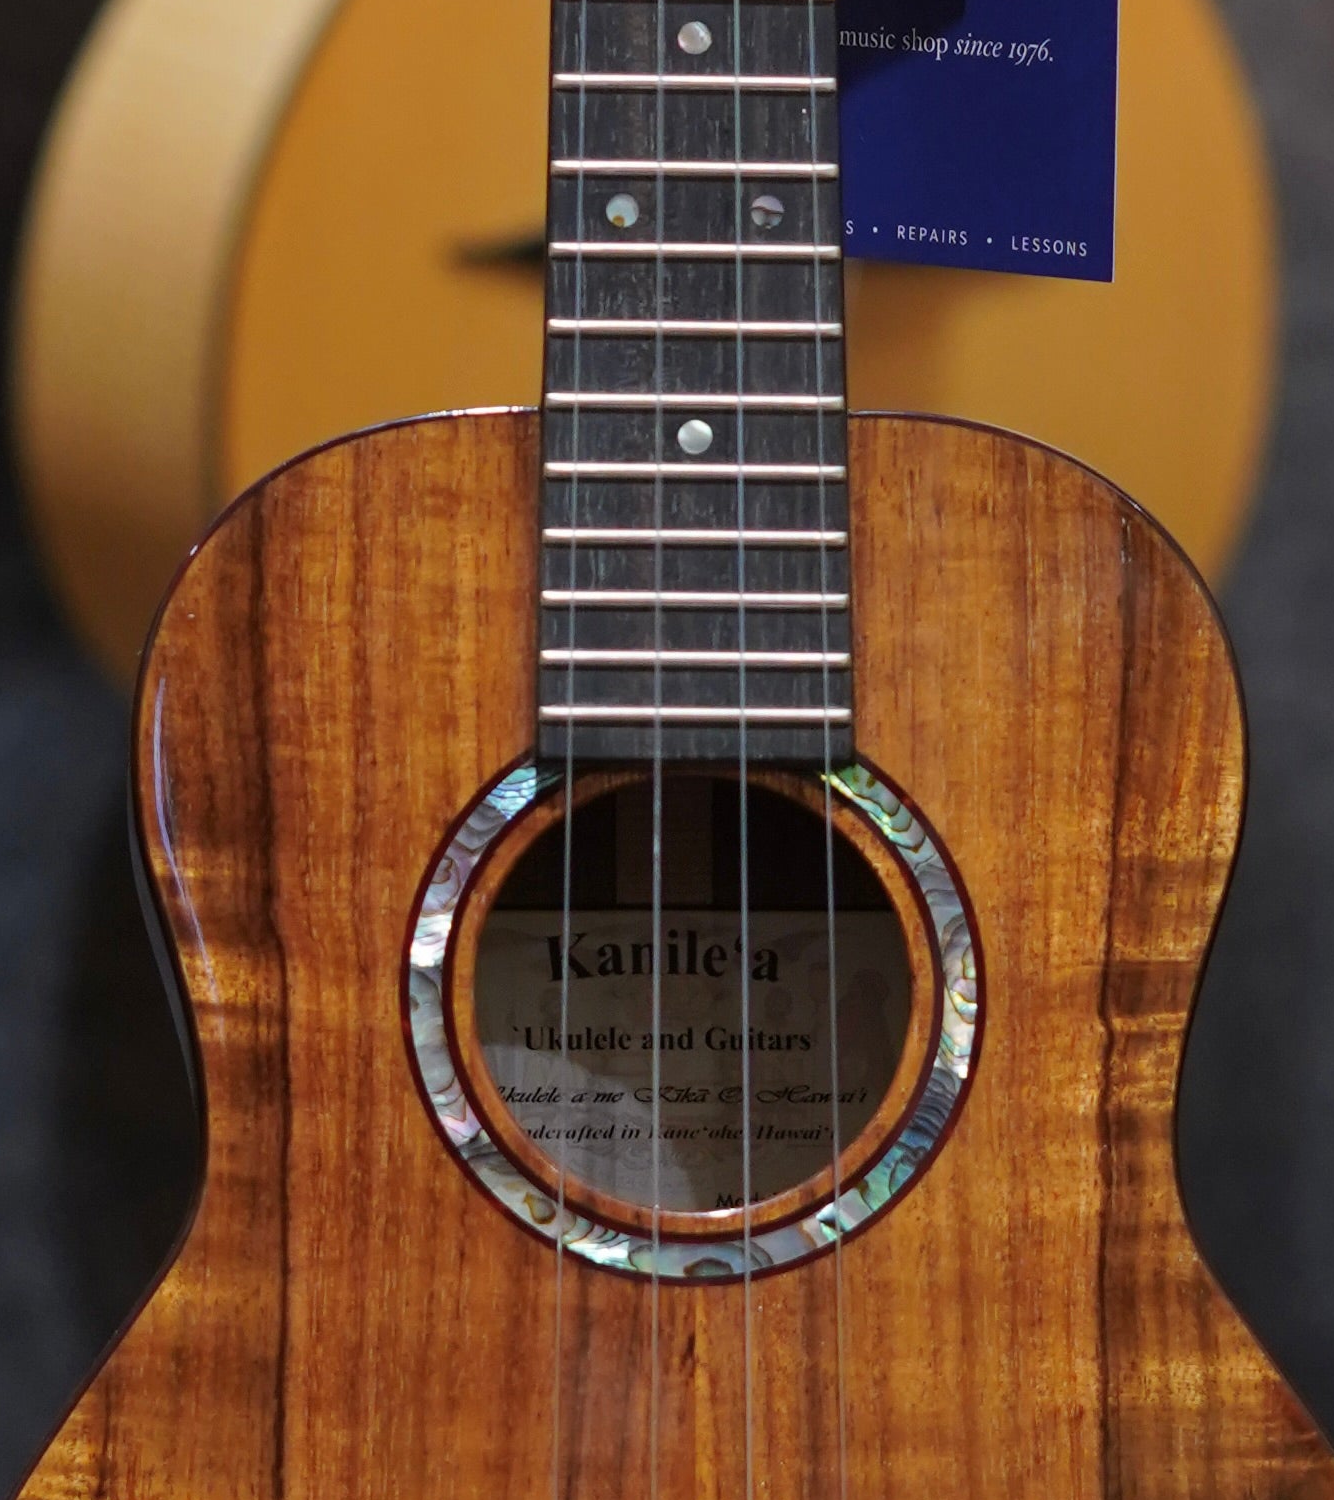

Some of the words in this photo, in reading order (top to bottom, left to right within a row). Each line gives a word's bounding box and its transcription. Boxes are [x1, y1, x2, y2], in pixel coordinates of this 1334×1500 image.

[839, 26, 896, 50] music
[902, 27, 949, 61] shop
[954, 33, 1003, 58] since
[1008, 38, 1054, 66] 1976.
[897, 224, 968, 246] REPAIRS
[1012, 235, 1088, 257] LESSONS
[642, 1027, 693, 1051] and
[704, 1025, 812, 1051] Guitars
[593, 1091, 625, 1103] me
[621, 1124, 641, 1140] in
